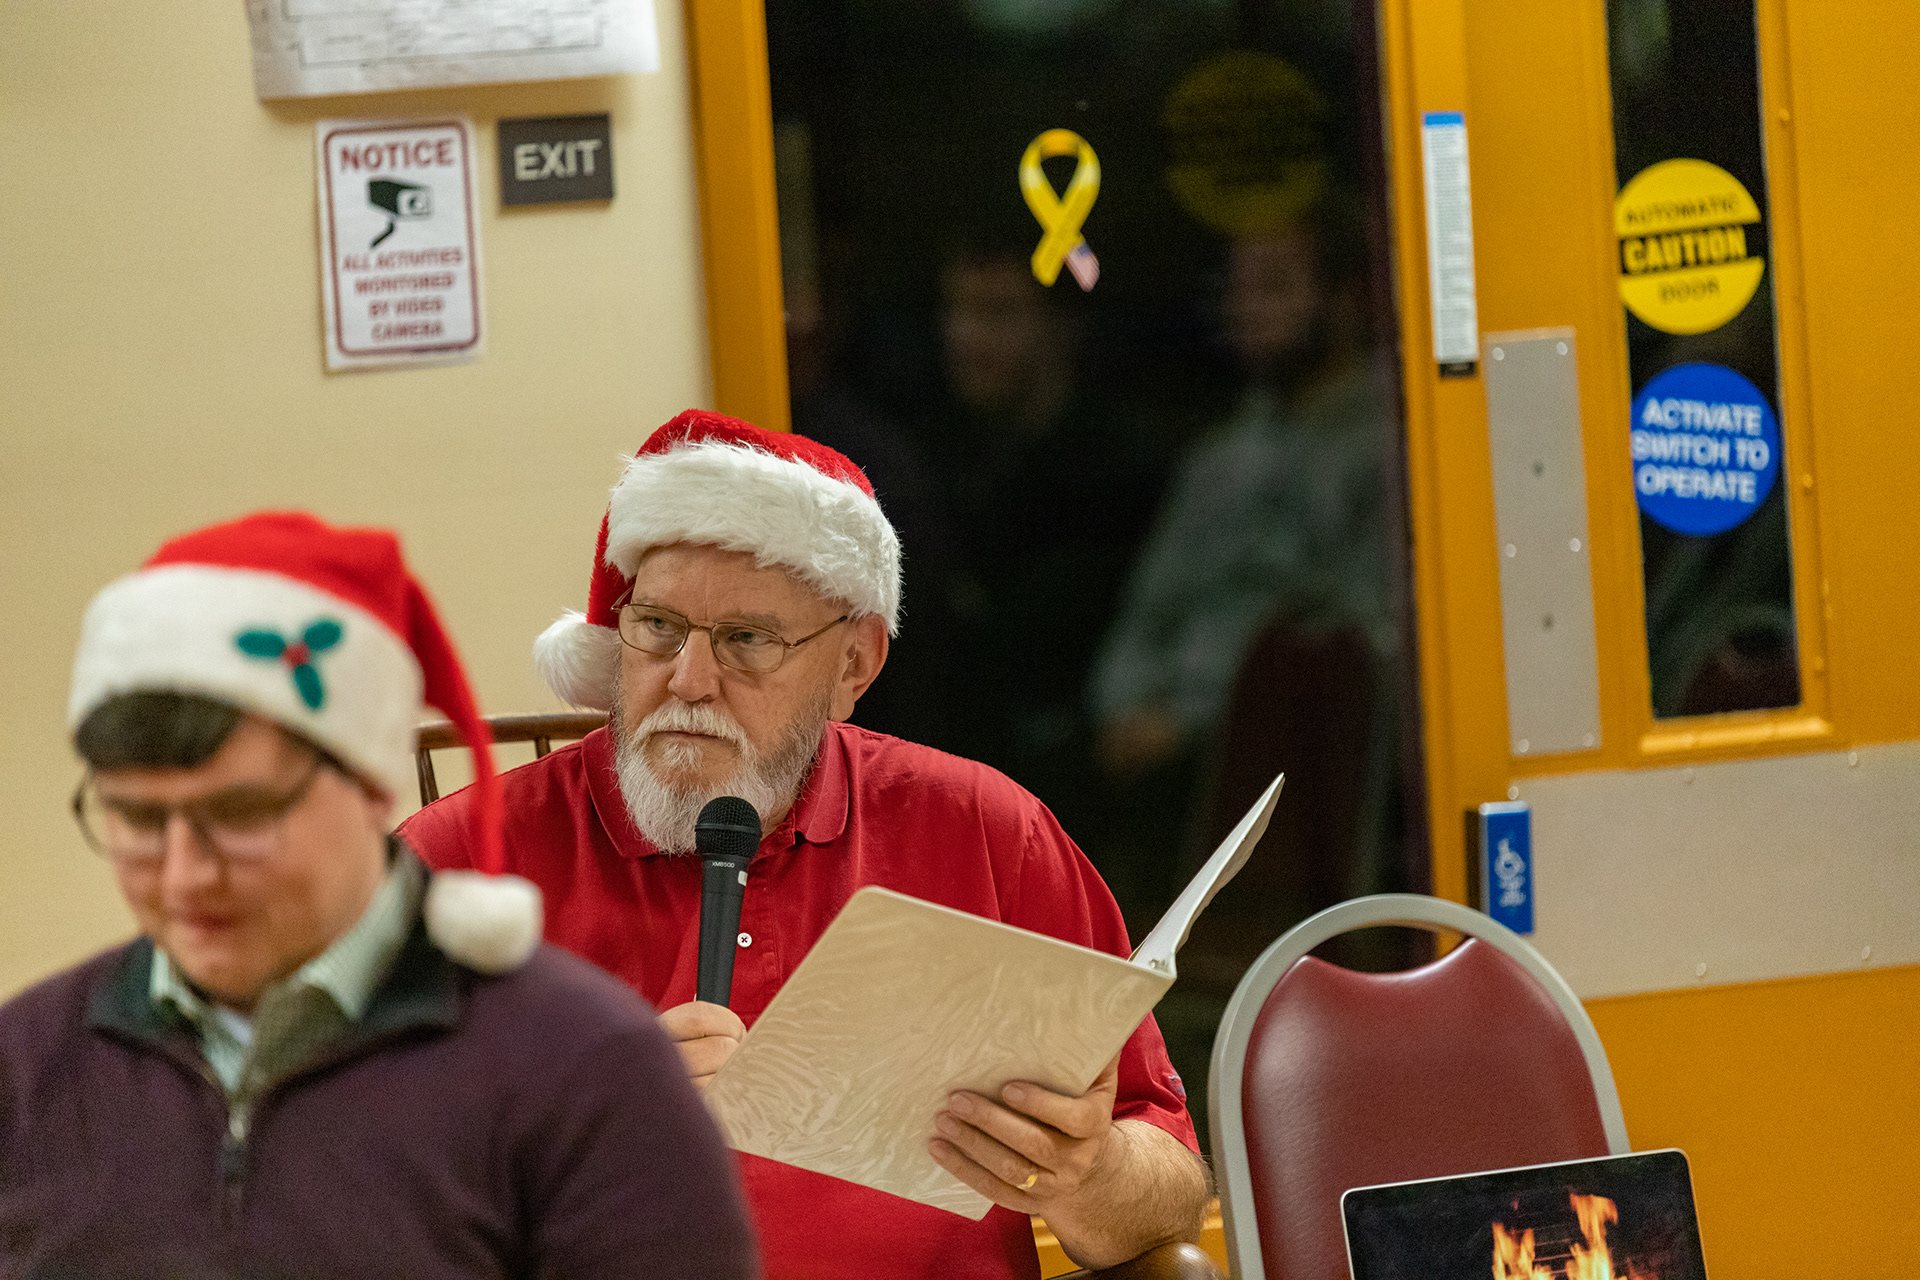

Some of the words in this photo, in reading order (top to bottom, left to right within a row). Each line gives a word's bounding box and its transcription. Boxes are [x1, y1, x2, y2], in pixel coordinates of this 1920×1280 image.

[341, 140, 453, 170] NOTICE
[514, 140, 600, 180] EXIT
[1626, 195, 1737, 225] AUTOMATIC
[344, 256, 369, 271] ALL
[378, 249, 461, 269] ACTIVITIES
[1625, 228, 1745, 274] CAUTION
[356, 274, 453, 294] MONITORED
[1659, 278, 1718, 303] DOOR
[370, 302, 386, 317] BY
[395, 299, 442, 315] VIDEO
[372, 322, 442, 341] CAMERA
[1643, 399, 1761, 435] ACTIVATE
[1632, 432, 1728, 467] SWITCH
[1736, 440, 1768, 470] TO
[1637, 467, 1755, 503] OPERATE
